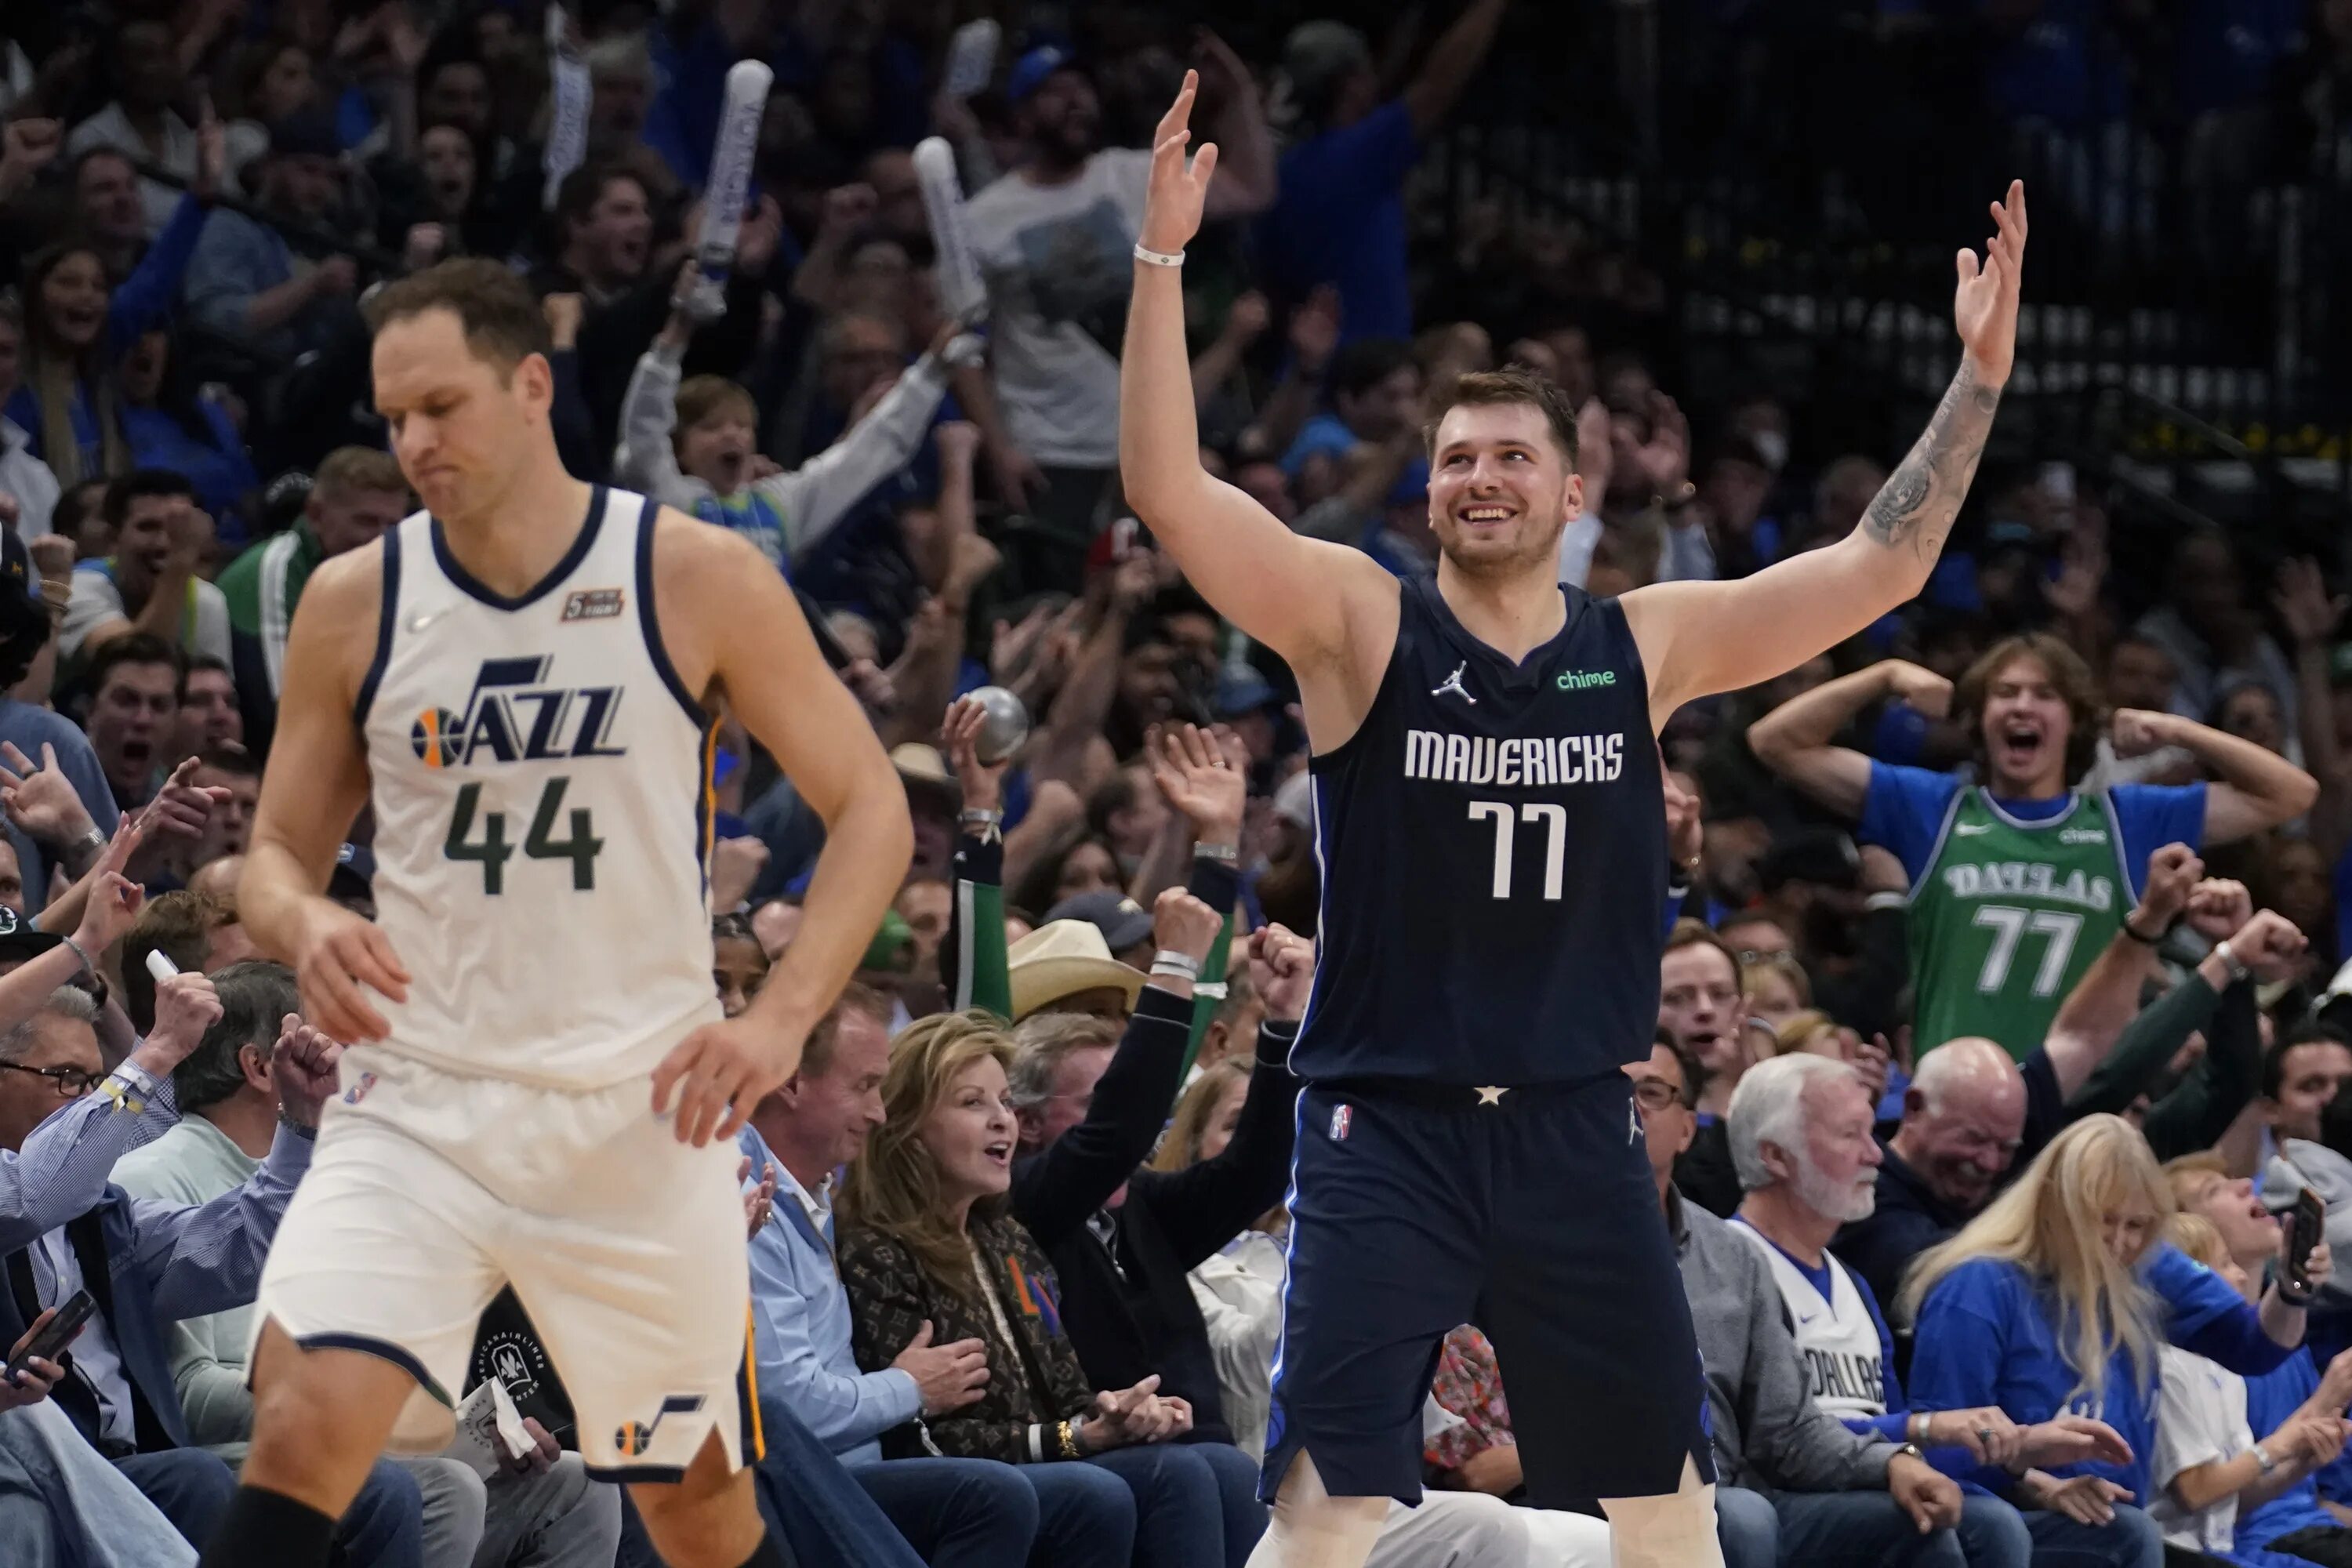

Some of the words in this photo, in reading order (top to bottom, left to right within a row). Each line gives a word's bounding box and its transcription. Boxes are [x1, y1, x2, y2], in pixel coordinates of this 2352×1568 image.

[412, 654, 627, 768] JAZZ
[1557, 670, 1617, 689] chime
[1404, 729, 1624, 785] MAVERICKS
[445, 775, 604, 895] 44
[1468, 800, 1566, 900] 77
[1944, 862, 2114, 912] DALLAS
[1972, 905, 2085, 1000] 77
[501, 1331, 545, 1370] AIRLINES
